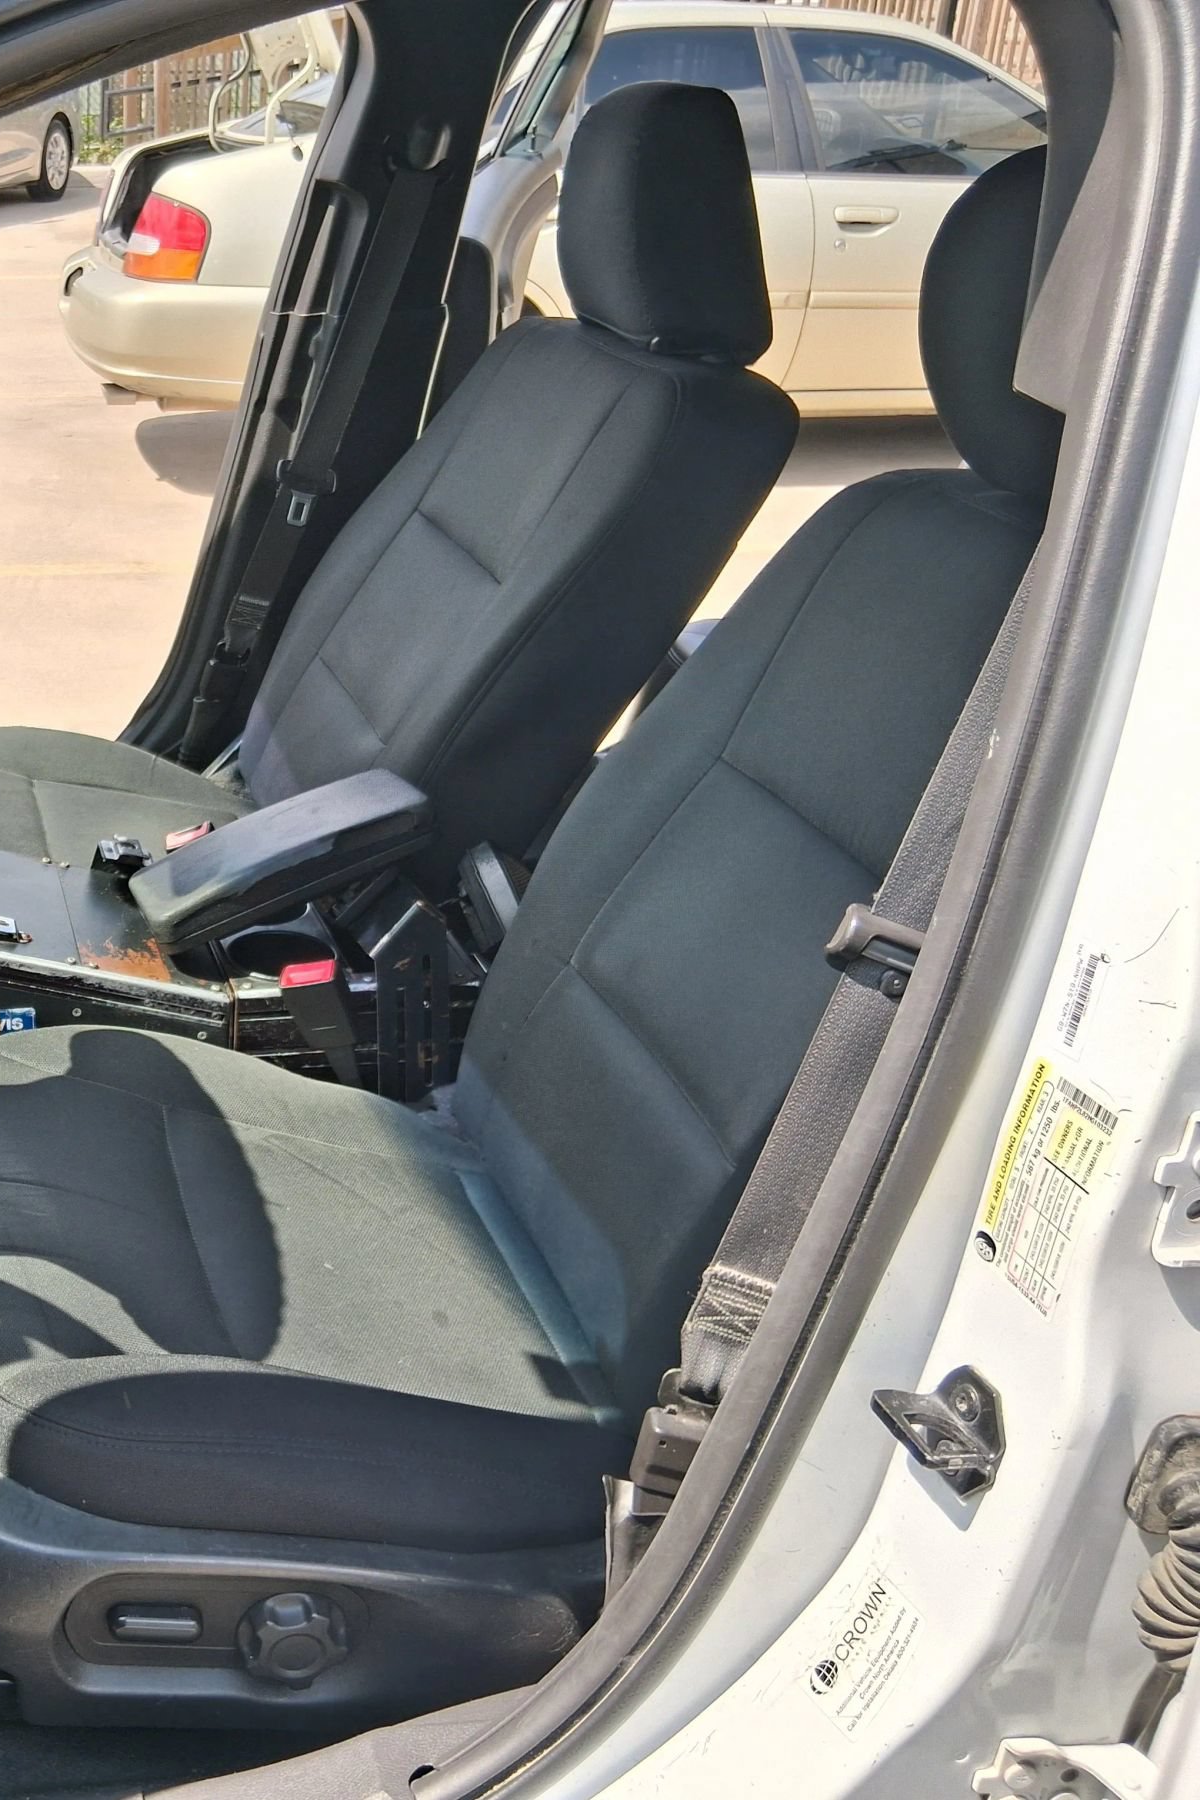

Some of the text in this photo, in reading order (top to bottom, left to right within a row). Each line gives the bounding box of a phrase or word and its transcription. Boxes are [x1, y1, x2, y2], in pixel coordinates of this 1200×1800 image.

[986, 1063, 1046, 1225] TIRE AND LOADING INFORMATION
[1031, 1148, 1041, 1159] kg
[1037, 1138, 1044, 1148] or
[1041, 1116, 1053, 1137] 1250
[1050, 1100, 1061, 1114] lbs.
[1052, 1119, 1073, 1163] SEE OWNERS
[1081, 1140, 1105, 1185] NFORMATION
[835, 1582, 886, 1661] CROWN
[859, 1639, 900, 1699] Crown North America
[847, 1717, 858, 1732] Call
[862, 1678, 886, 1711] Installation
